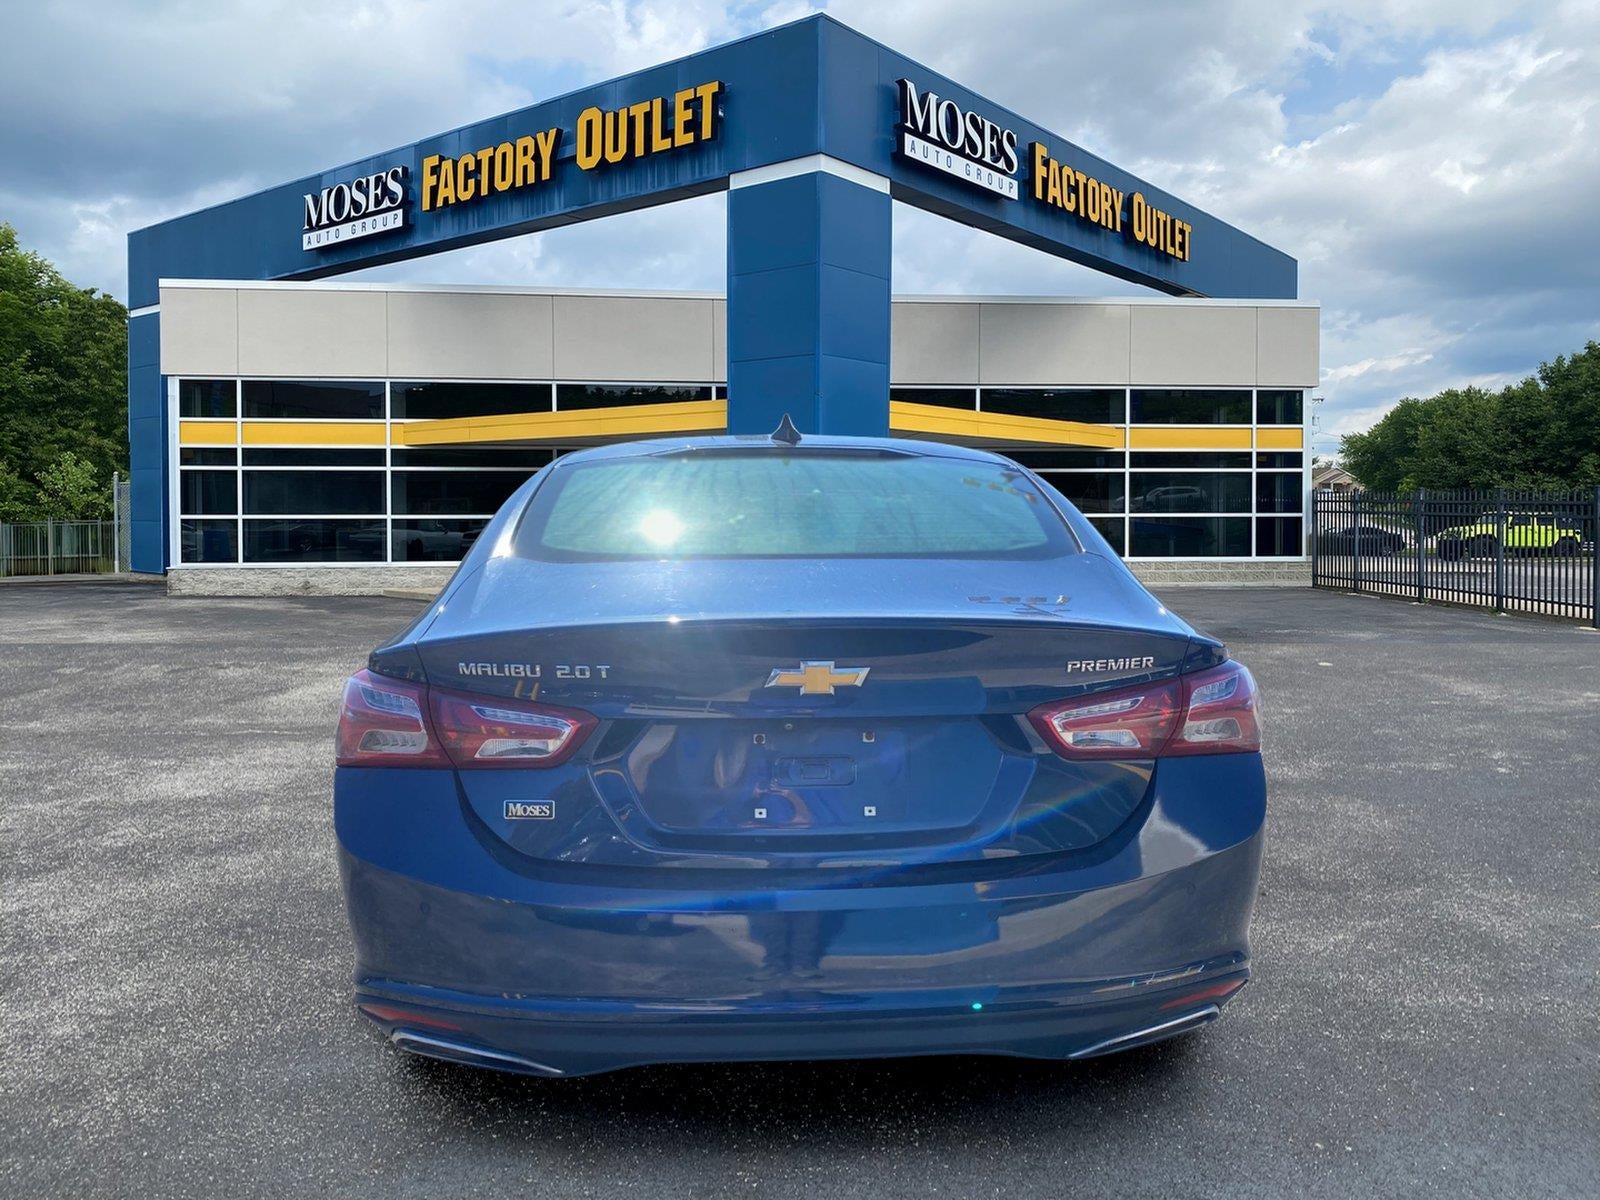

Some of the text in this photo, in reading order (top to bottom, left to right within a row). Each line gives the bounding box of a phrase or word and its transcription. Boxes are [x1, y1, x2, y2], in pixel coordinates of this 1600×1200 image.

[421, 80, 722, 212] FACTORY OUTLET
[903, 78, 1019, 175] MOSES
[909, 139, 1015, 195] AUTO GROUP
[303, 165, 404, 230] MOSES
[1034, 142, 1193, 262] FACTORY OUTLET
[306, 213, 400, 247] AUTO GROUP
[458, 662, 542, 678] MALIBU
[1066, 656, 1154, 673] PREMIER
[508, 802, 550, 817] MOSES
